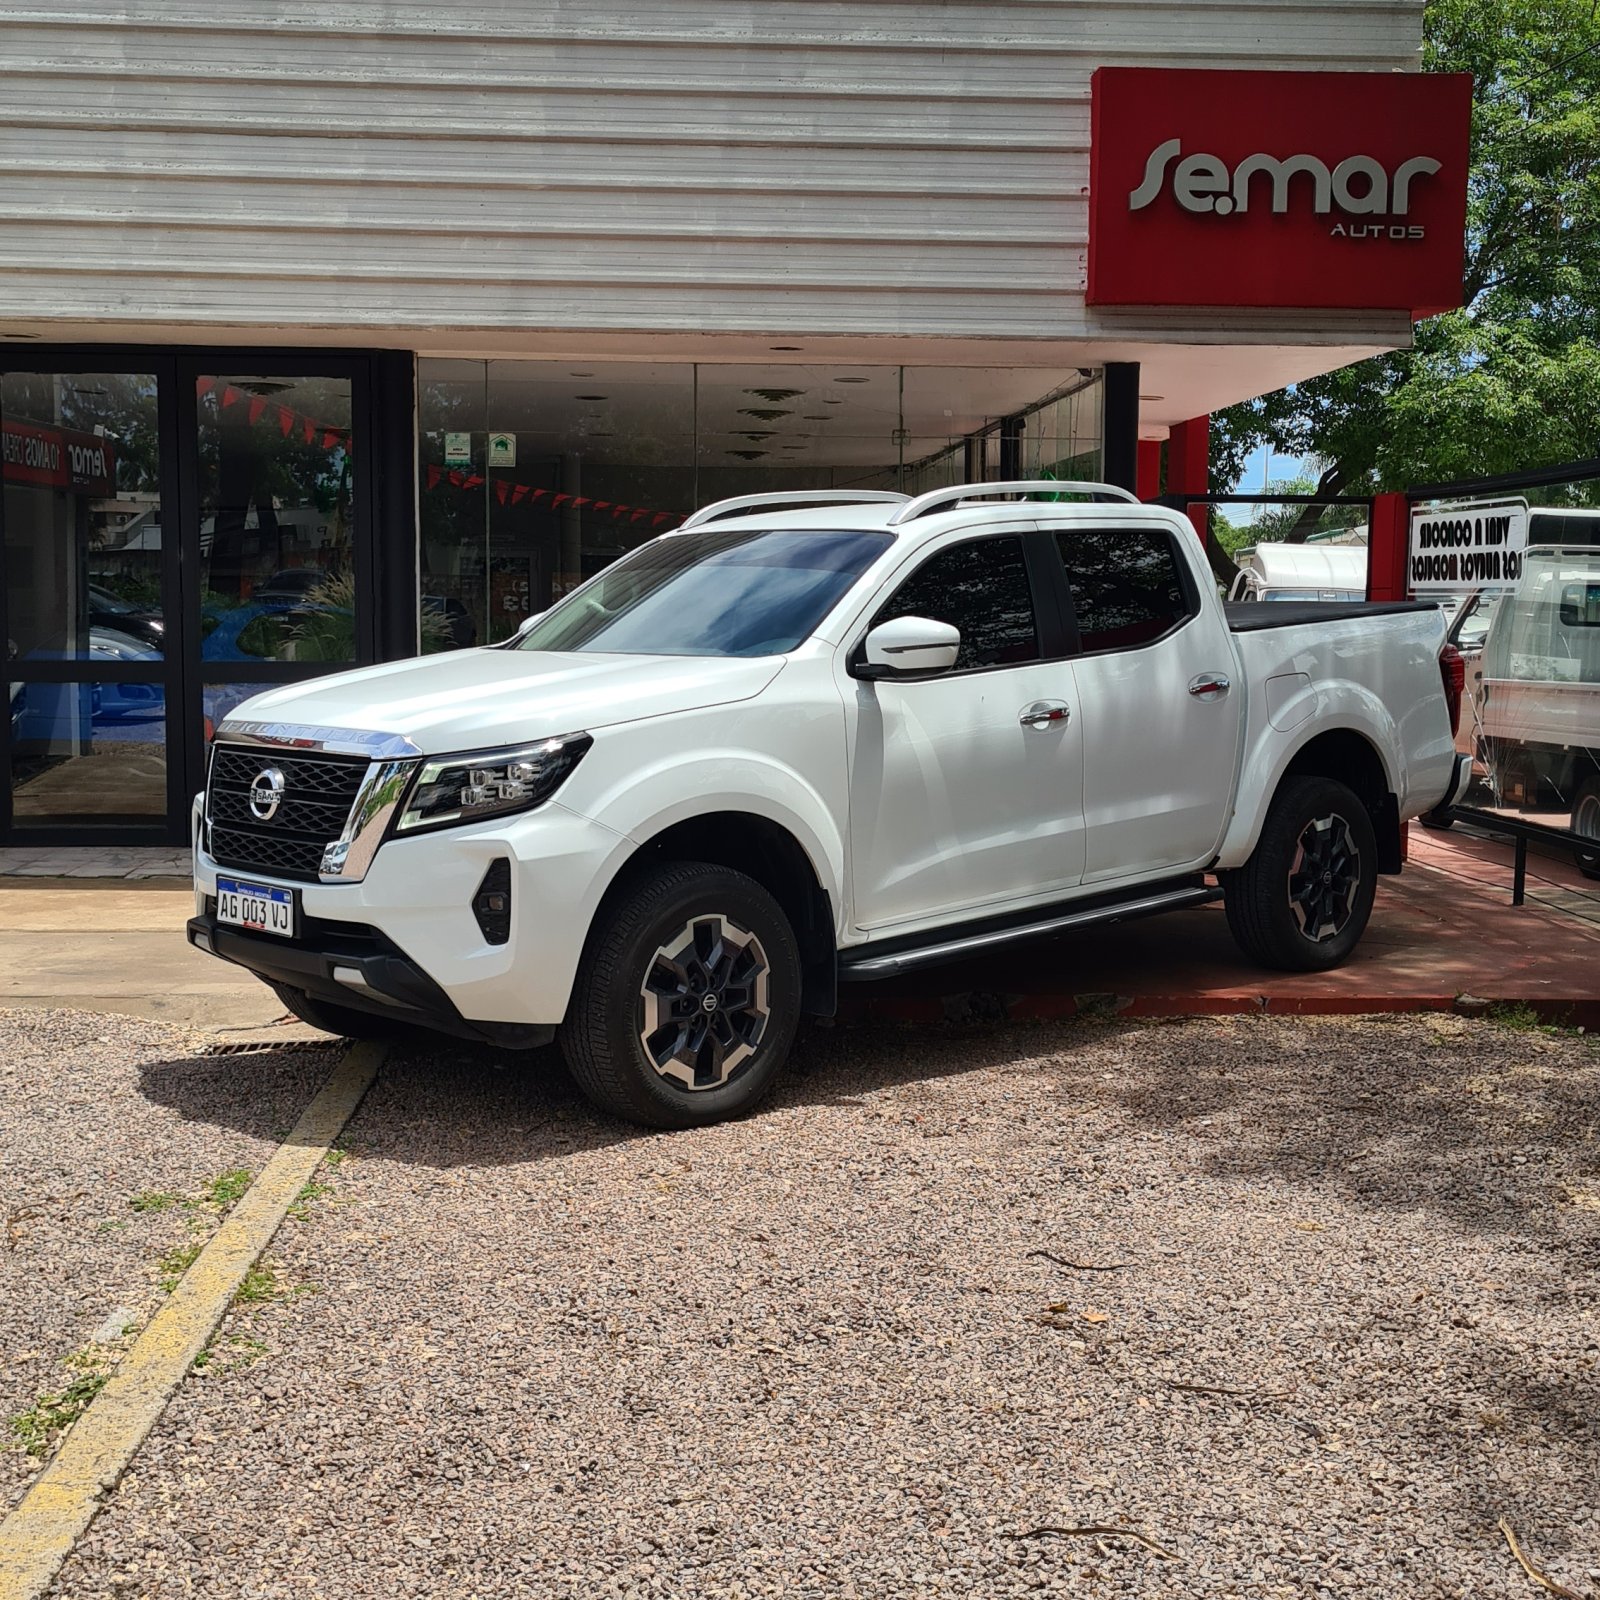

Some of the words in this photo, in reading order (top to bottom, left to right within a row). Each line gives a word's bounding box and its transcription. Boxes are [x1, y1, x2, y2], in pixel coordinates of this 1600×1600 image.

[1330, 223, 1425, 239] AUTOS
[224, 720, 367, 743] FRONTIER
[220, 893, 238, 918] AG
[242, 898, 266, 924] 003
[271, 903, 288, 929] VJ
